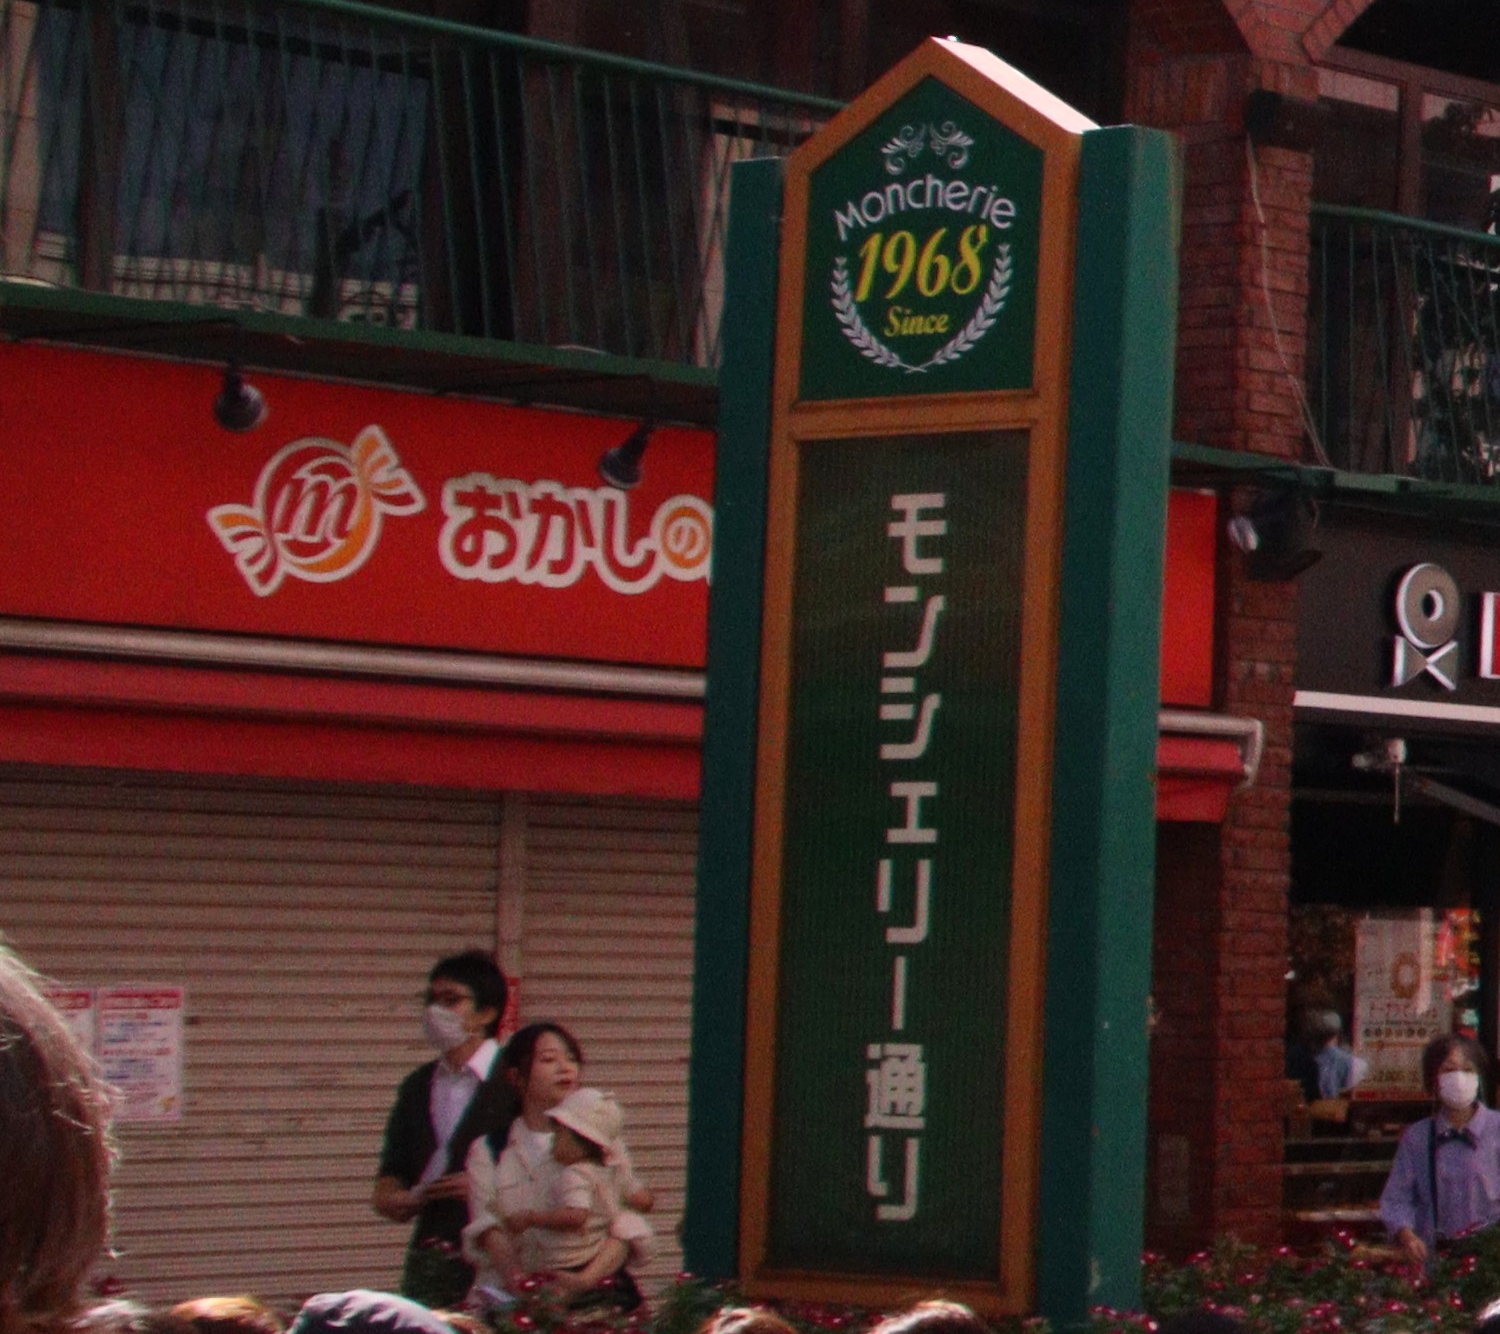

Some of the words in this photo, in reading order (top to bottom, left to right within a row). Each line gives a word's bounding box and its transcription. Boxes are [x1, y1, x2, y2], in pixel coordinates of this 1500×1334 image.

[833, 173, 1016, 242] Moncherie
[855, 224, 989, 303] 1968
[883, 305, 949, 338] Since
[863, 491, 950, 1224] モンシェリー通り
